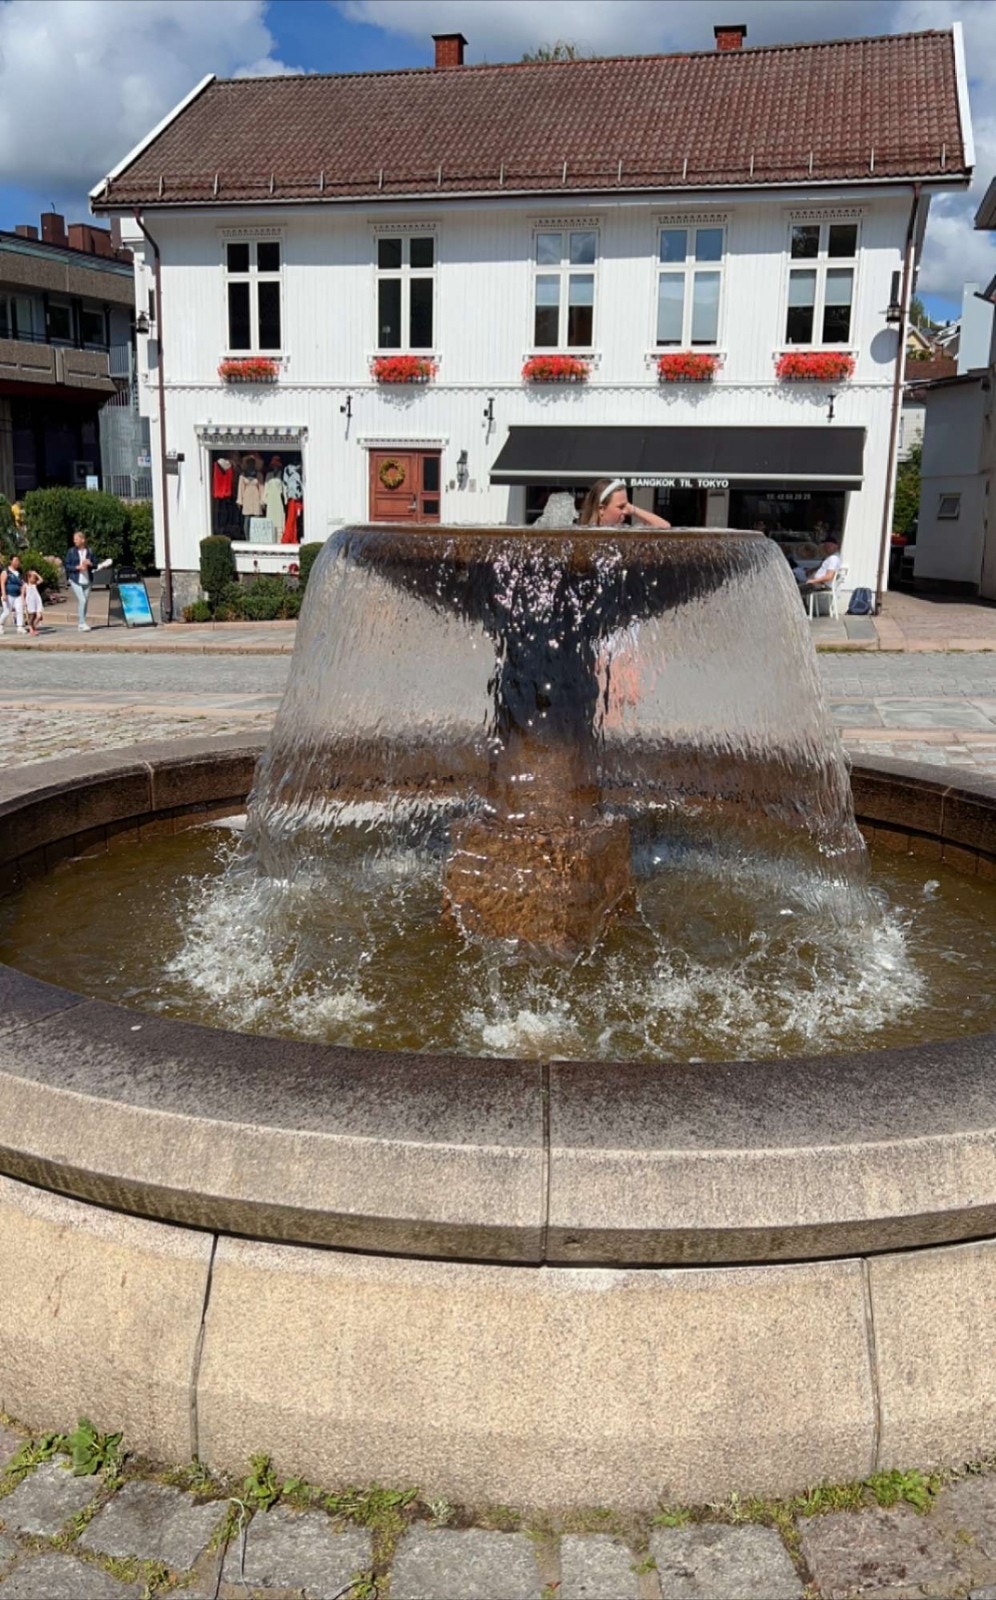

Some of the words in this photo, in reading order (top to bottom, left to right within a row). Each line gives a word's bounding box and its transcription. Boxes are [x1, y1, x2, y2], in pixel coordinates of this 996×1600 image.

[630, 478, 675, 487] BANGKOK
[680, 479, 693, 488] TIL
[697, 479, 729, 488] TOKYO
